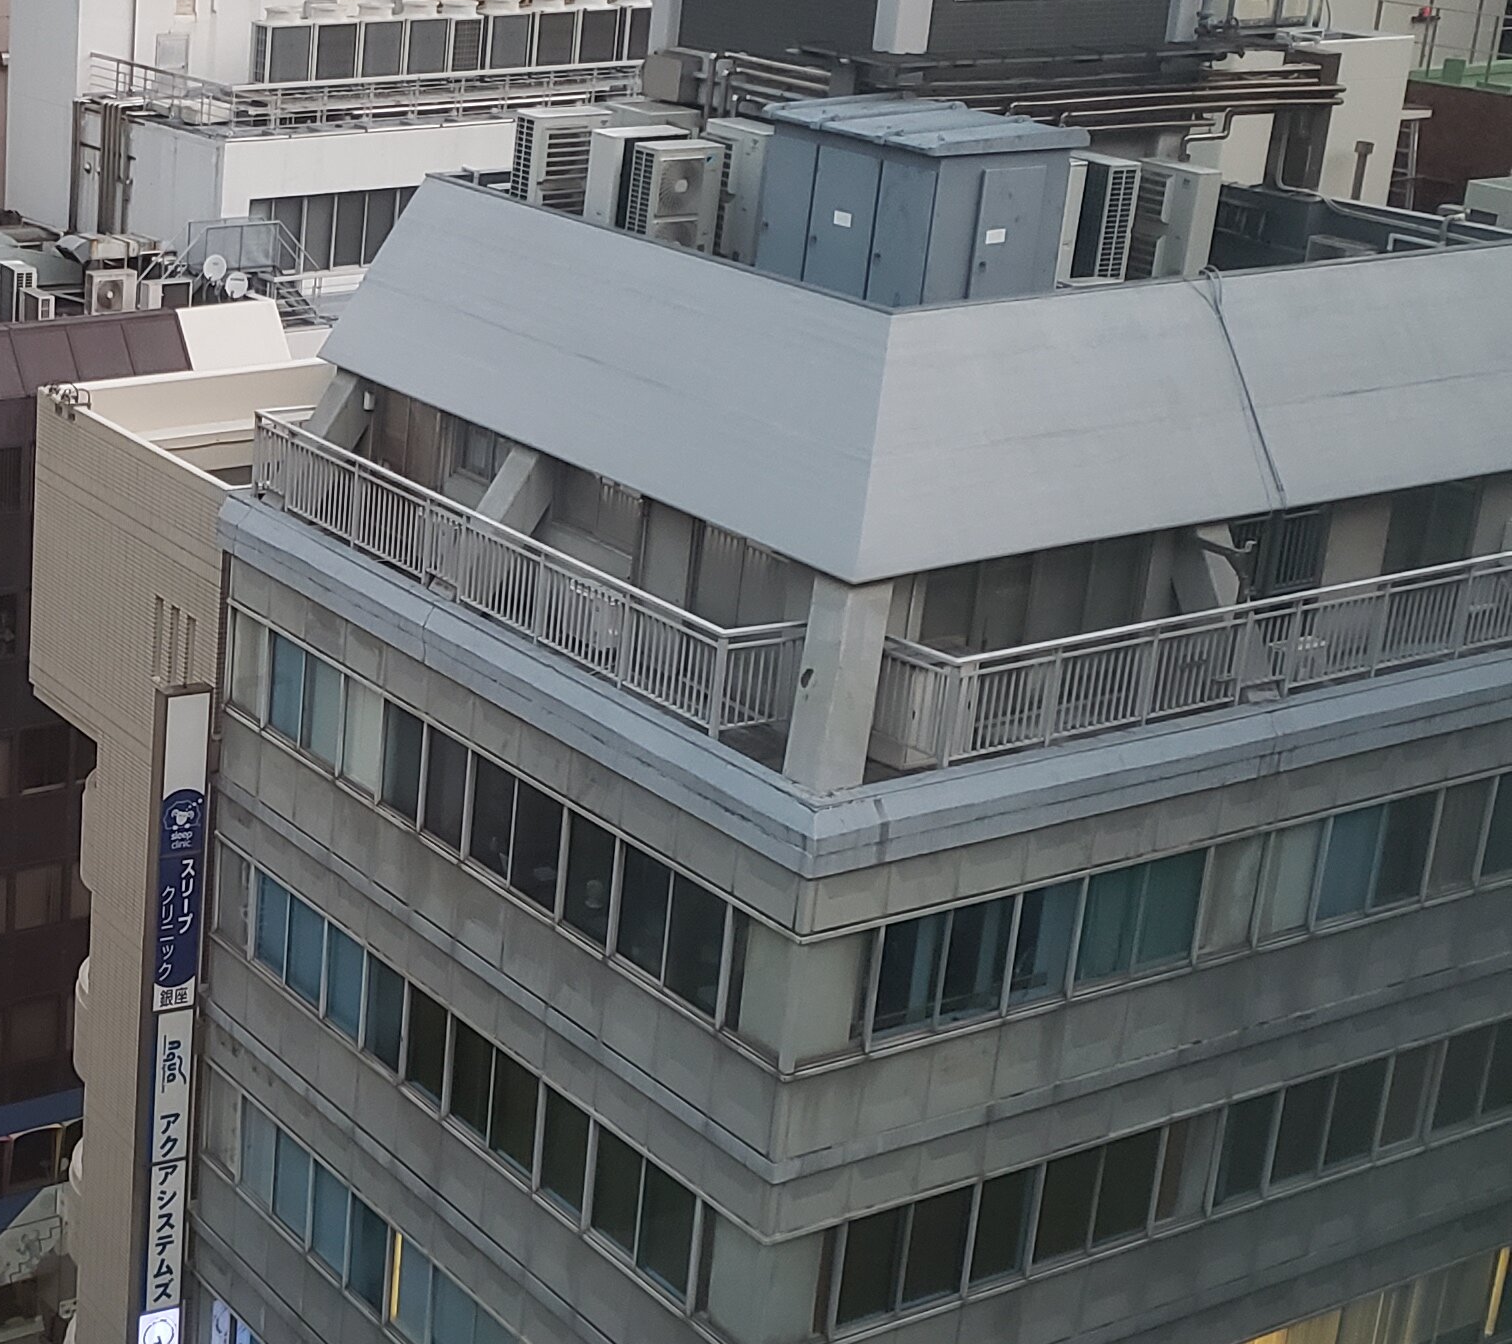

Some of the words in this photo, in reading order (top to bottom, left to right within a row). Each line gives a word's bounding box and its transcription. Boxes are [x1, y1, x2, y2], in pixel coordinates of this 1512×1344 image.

[170, 830, 194, 842] sleep
[171, 840, 192, 850] clinic
[178, 859, 195, 935] スリープ
[158, 886, 176, 982] クリニック
[159, 986, 188, 1007] 銀座
[153, 1112, 181, 1303] アクアシステムズ
